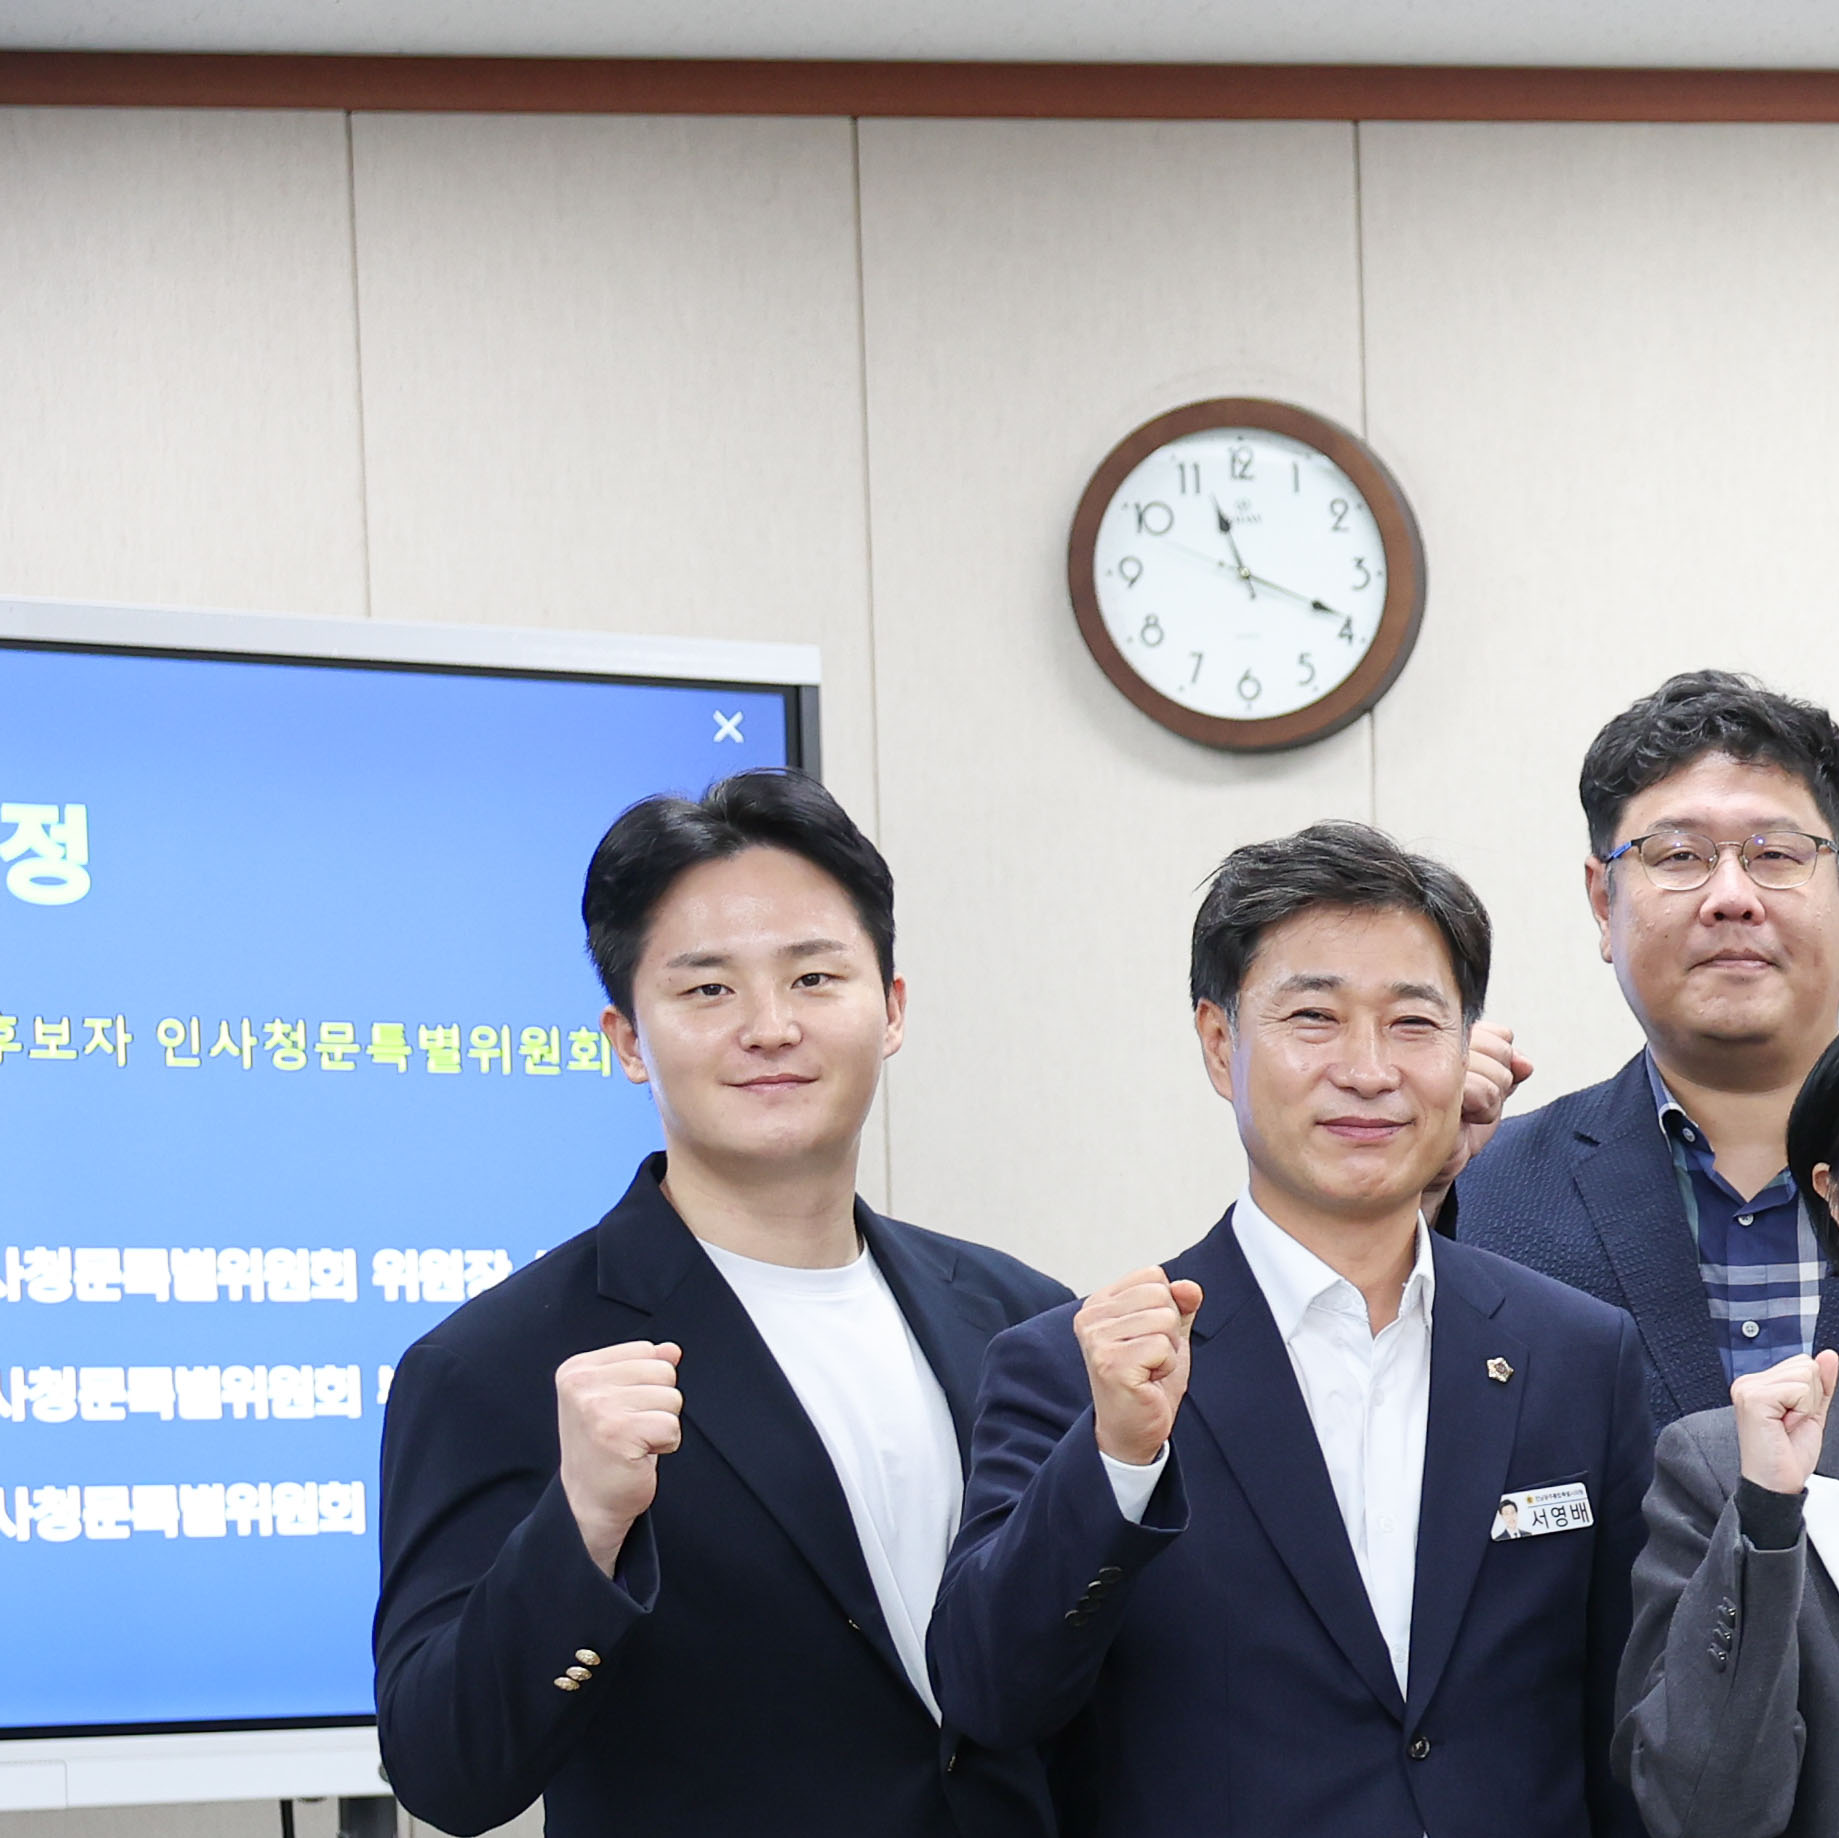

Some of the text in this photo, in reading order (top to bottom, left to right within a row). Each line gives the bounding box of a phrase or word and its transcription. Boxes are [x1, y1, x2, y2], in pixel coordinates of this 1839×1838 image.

[1178, 462, 1201, 495] 11
[1228, 445, 1254, 481] 12
[1290, 463, 1301, 493] 1
[1134, 500, 1175, 536] 10
[1329, 497, 1350, 532] 2
[1117, 554, 1144, 589] 9
[1351, 556, 1371, 591] 3
[1139, 614, 1164, 647] 8
[1337, 616, 1354, 646] 4
[1189, 651, 1204, 684] 7
[1298, 652, 1316, 685] 5
[1236, 669, 1262, 701] 6
[0, 802, 92, 906] 정
[156, 1015, 612, 1077] 인사청문특별위원회
[1532, 1502, 1590, 1529] 서영배
